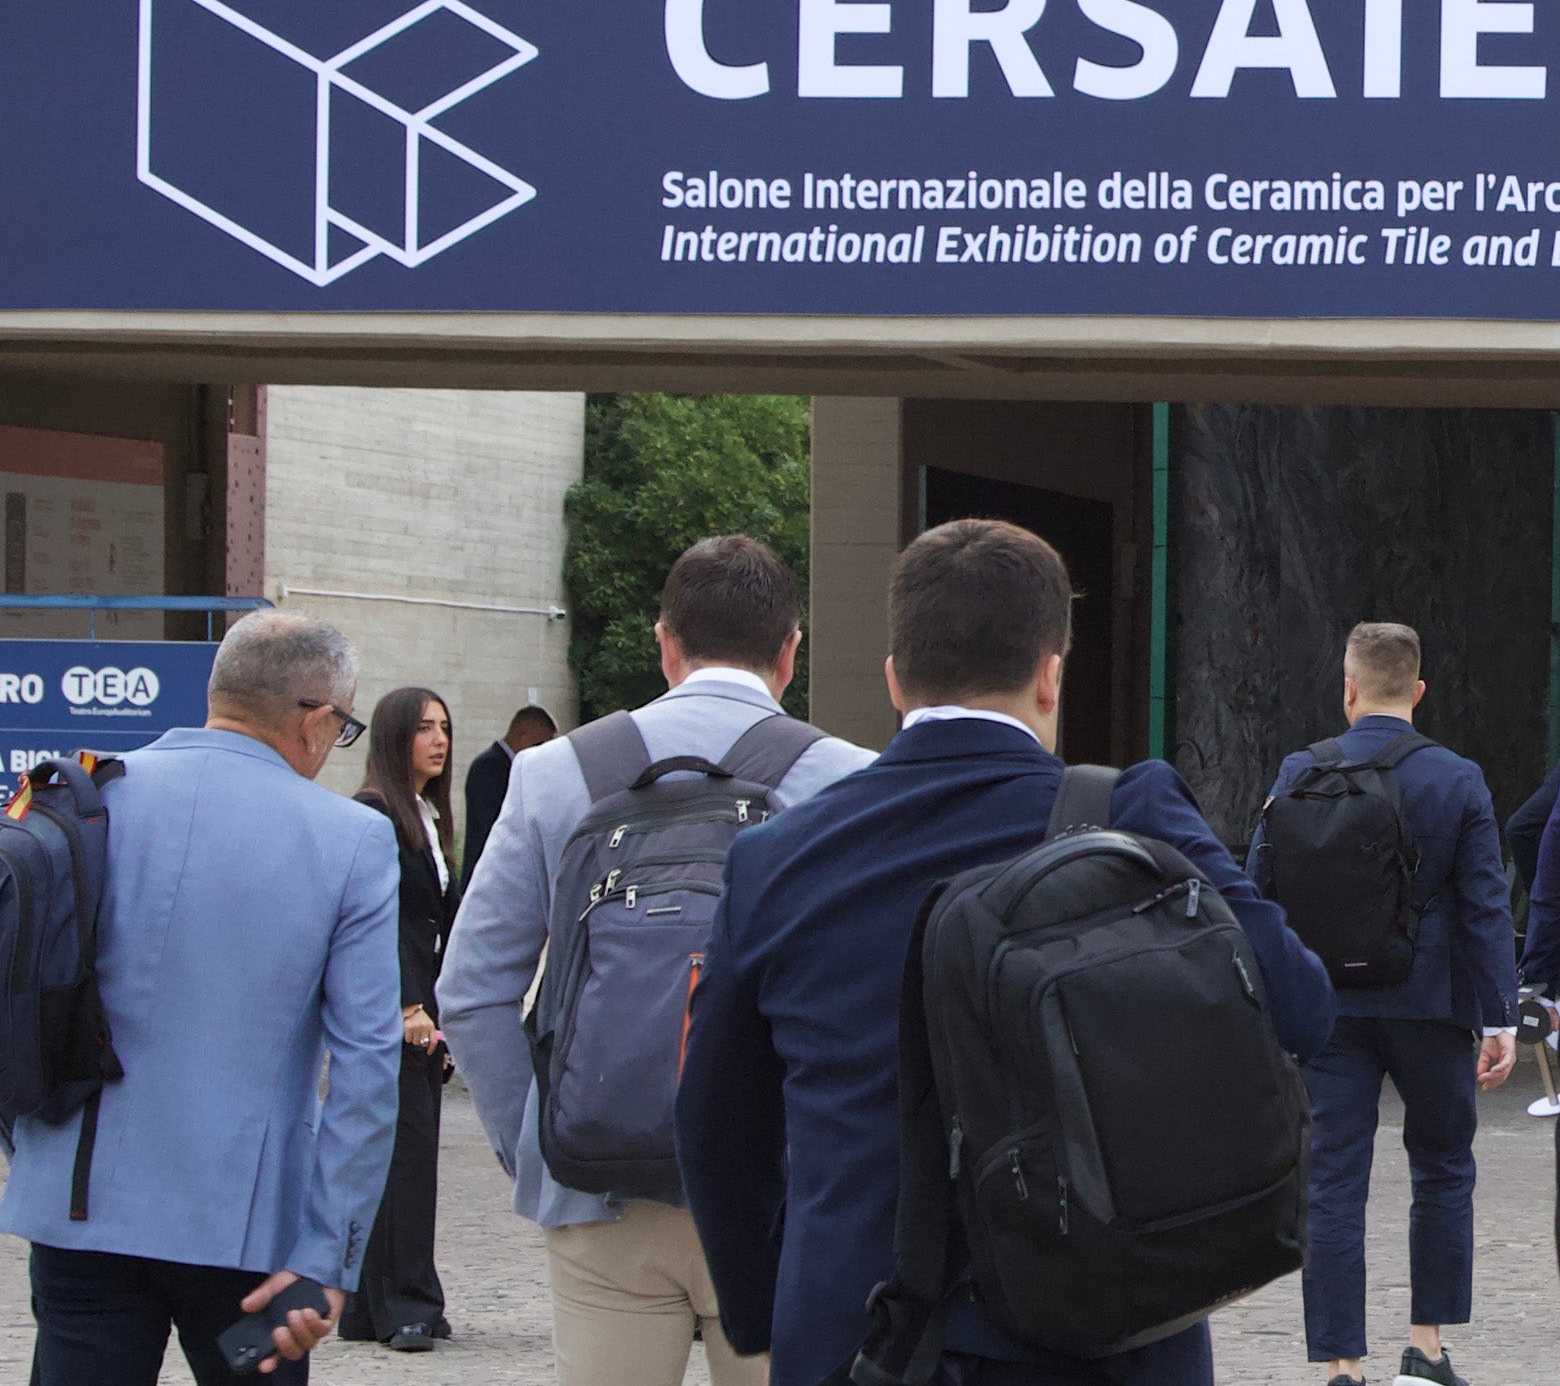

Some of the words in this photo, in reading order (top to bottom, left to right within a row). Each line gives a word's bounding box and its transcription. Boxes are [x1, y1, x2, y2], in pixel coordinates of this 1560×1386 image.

[663, 171, 790, 208] Salone
[804, 171, 1086, 209] Internazionale
[1098, 172, 1192, 209] della
[1205, 173, 1384, 210] Ceramica
[1398, 181, 1463, 217] per
[661, 225, 924, 262] International
[936, 225, 1141, 262] Exhibition
[1155, 226, 1197, 263] of
[1208, 226, 1368, 264] Ceramic
[1382, 227, 1450, 264] Tile
[1463, 229, 1539, 266] and
[71, 673, 150, 698] TEA
